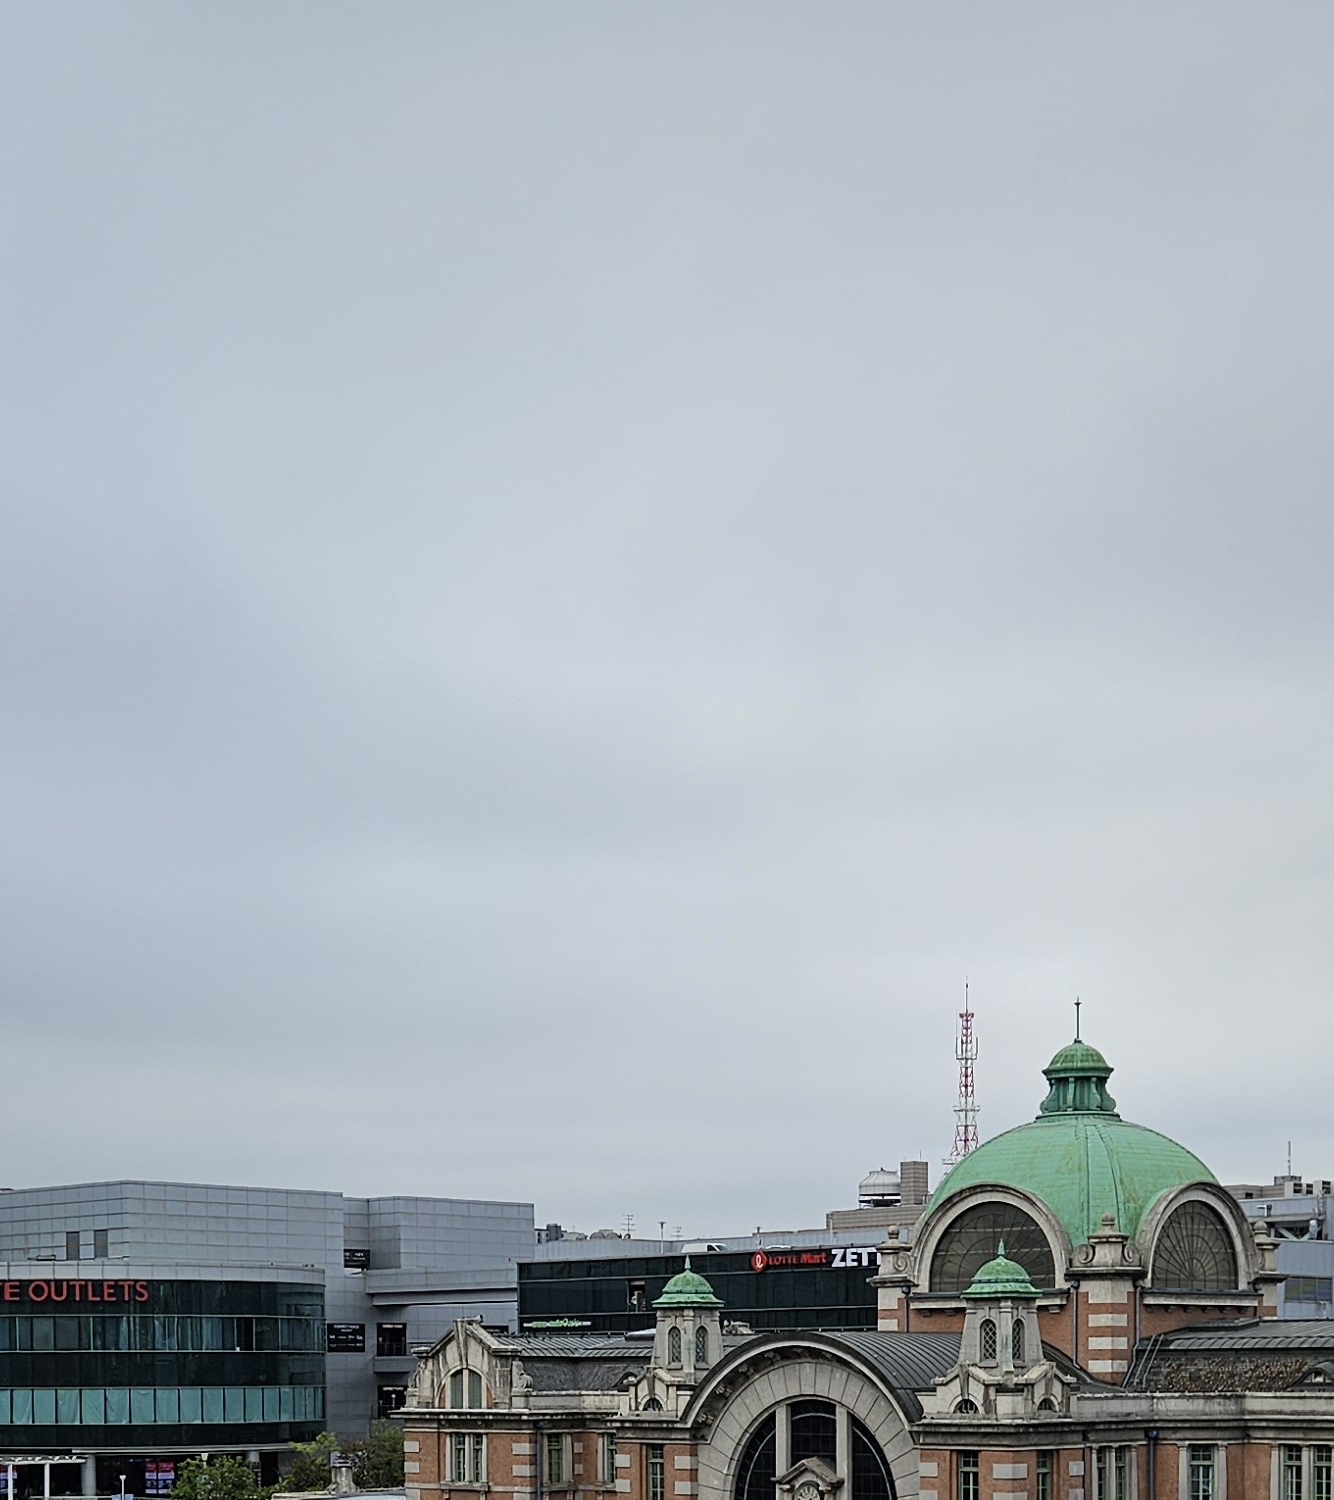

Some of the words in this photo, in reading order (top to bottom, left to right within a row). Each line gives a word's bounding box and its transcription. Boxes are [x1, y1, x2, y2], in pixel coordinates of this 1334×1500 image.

[769, 1255, 799, 1265] LOTTE
[800, 1252, 827, 1264] Mart
[28, 1281, 149, 1302] OUTLETS
